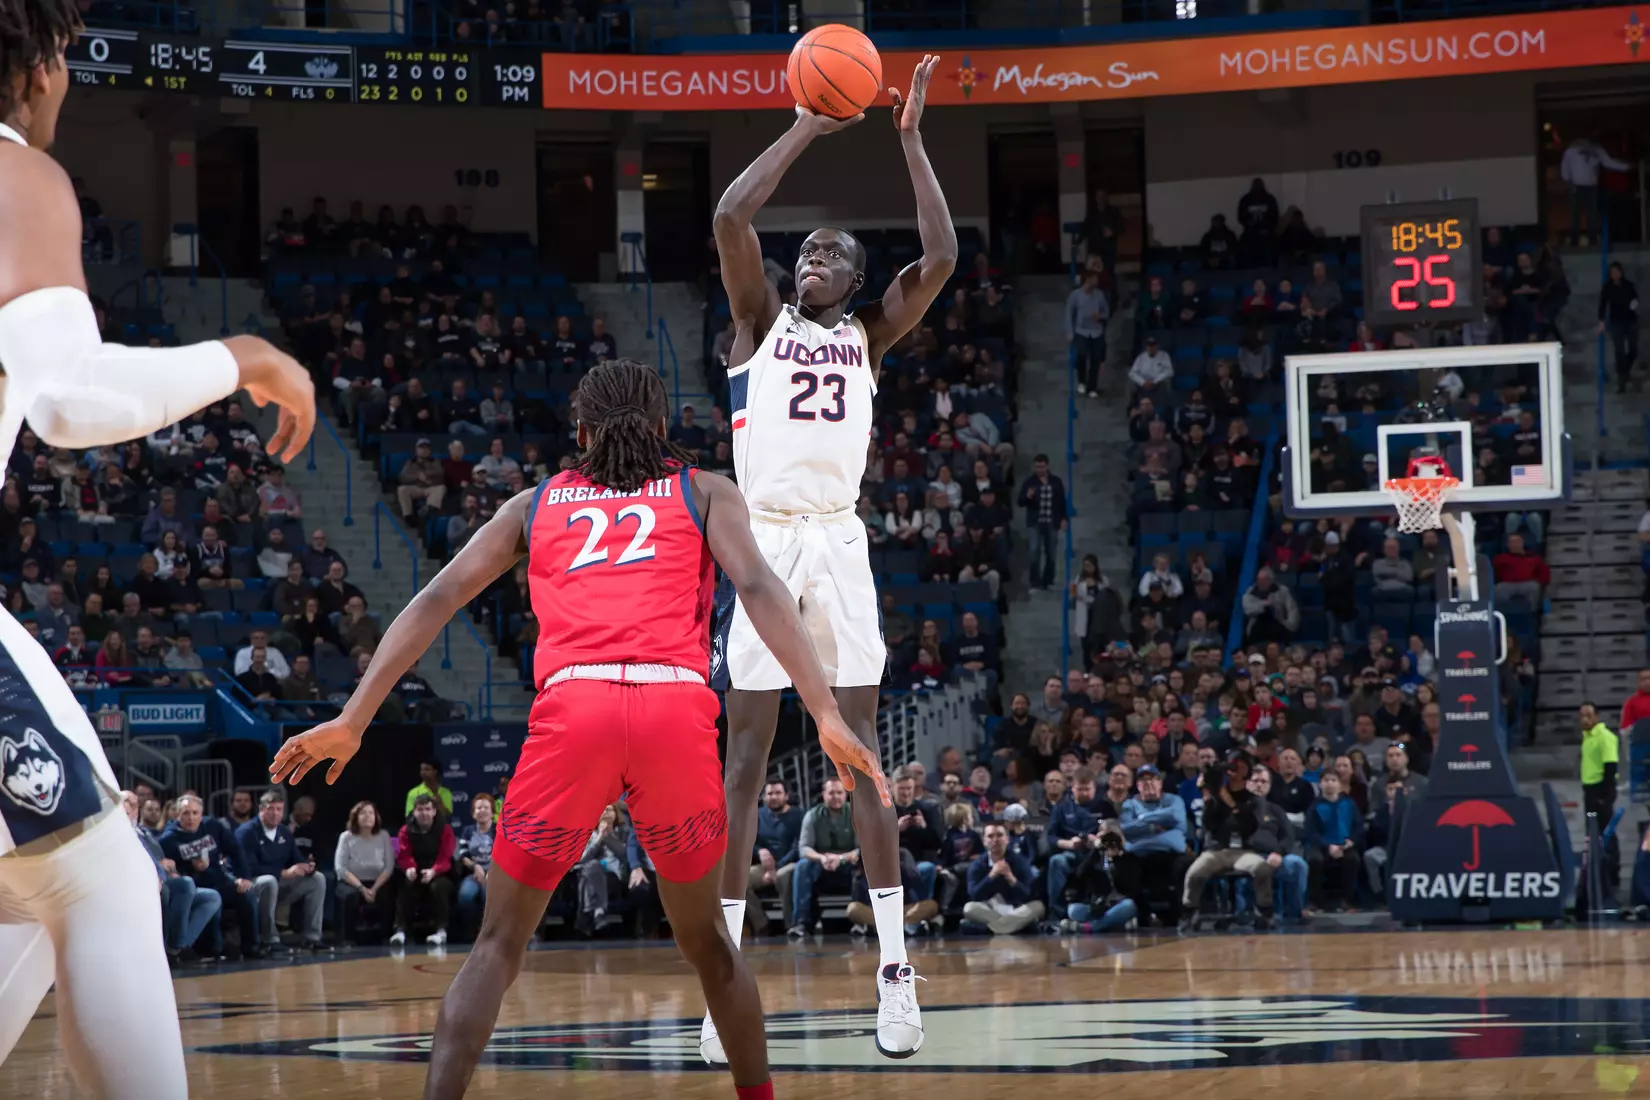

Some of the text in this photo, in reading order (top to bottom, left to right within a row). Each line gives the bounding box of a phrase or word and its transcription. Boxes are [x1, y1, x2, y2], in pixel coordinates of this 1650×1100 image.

[89, 38, 109, 62] 0
[151, 43, 213, 72] 18:45
[1219, 29, 1546, 76] MOHEGANSUN.COM
[247, 51, 267, 75] 4
[76, 72, 116, 85] TOL 4
[360, 64, 467, 81] 12 2 0 0 0
[494, 65, 536, 82] 1:09
[993, 62, 1159, 96] Mohegan Sun
[164, 76, 187, 89] 1ST
[232, 84, 273, 97] TOL 4
[292, 87, 335, 99] FLS 0
[360, 85, 468, 102] 23 2 0 1 0
[502, 86, 529, 101] PM
[1332, 149, 1381, 169] 109
[1392, 219, 1462, 252] 18:45
[1390, 254, 1456, 310] 25
[773, 337, 863, 368] UCONN
[788, 371, 847, 422] 23
[565, 504, 656, 575] 22
[1440, 610, 1488, 624] SPALDING
[1444, 667, 1488, 677] TRAVELERS
[132, 707, 202, 720] BUD LIGHT
[1444, 711, 1489, 721] TRAVELERS
[1447, 760, 1491, 770] TRAVELERS
[1391, 871, 1560, 899] TRAVELERS
